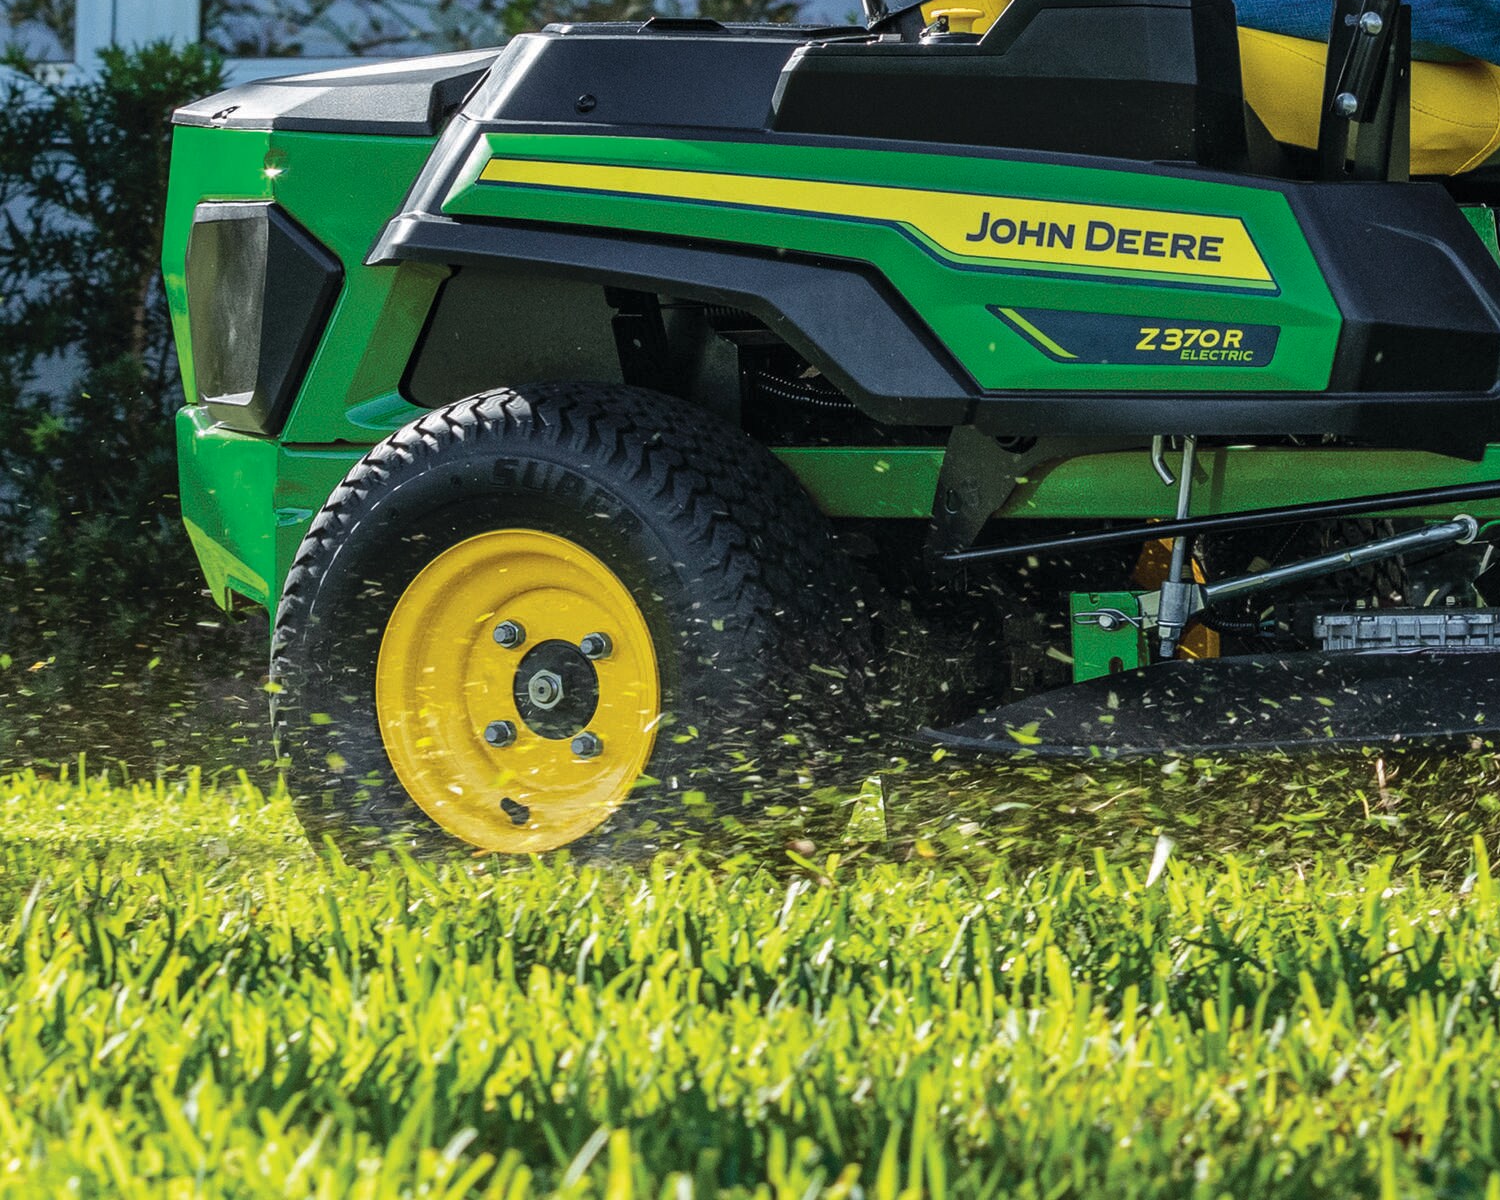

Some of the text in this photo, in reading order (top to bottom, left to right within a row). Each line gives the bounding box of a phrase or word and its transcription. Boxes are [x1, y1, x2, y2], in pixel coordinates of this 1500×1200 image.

[966, 212, 1224, 263] JOHN DEERE
[1180, 349, 1254, 362] ELECTRIC
